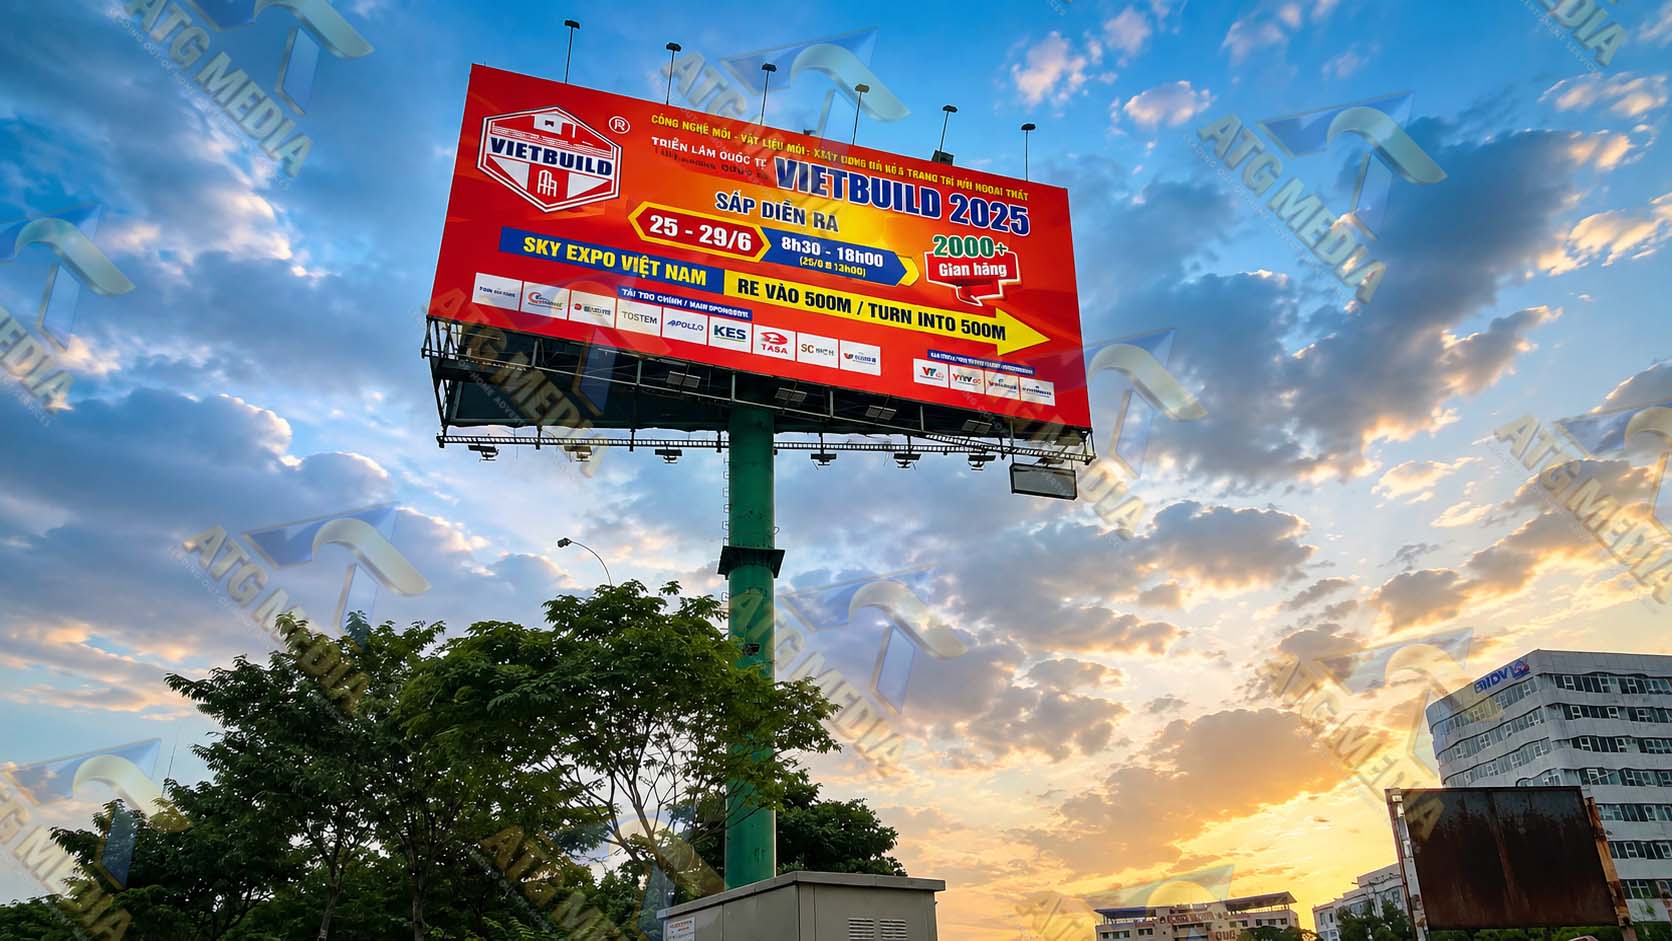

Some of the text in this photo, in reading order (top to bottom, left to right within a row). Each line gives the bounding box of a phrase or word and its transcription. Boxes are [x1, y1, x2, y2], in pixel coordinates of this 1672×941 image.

[490, 136, 613, 176] VIETBUILD
[774, 156, 941, 220] VIETBUILD
[949, 193, 1031, 236] 2025
[650, 215, 678, 237] 25
[699, 224, 752, 251] 29/6
[813, 211, 839, 233] RA
[781, 236, 821, 256] 8h30
[836, 246, 884, 268] 18h00
[932, 234, 1008, 259] 2000+
[523, 237, 706, 286] SKY EXPO VIỆT NAM
[939, 263, 970, 277] Gian
[622, 311, 658, 325] TOSTEM
[765, 282, 799, 304] VÀO
[804, 291, 851, 313] 500M
[857, 301, 863, 315] /
[868, 302, 912, 325] TURN
[918, 311, 956, 332] INTO
[961, 319, 1006, 341] 500M
[667, 320, 704, 333] APOLLO
[714, 324, 746, 340] KES
[761, 344, 788, 355] TASA
